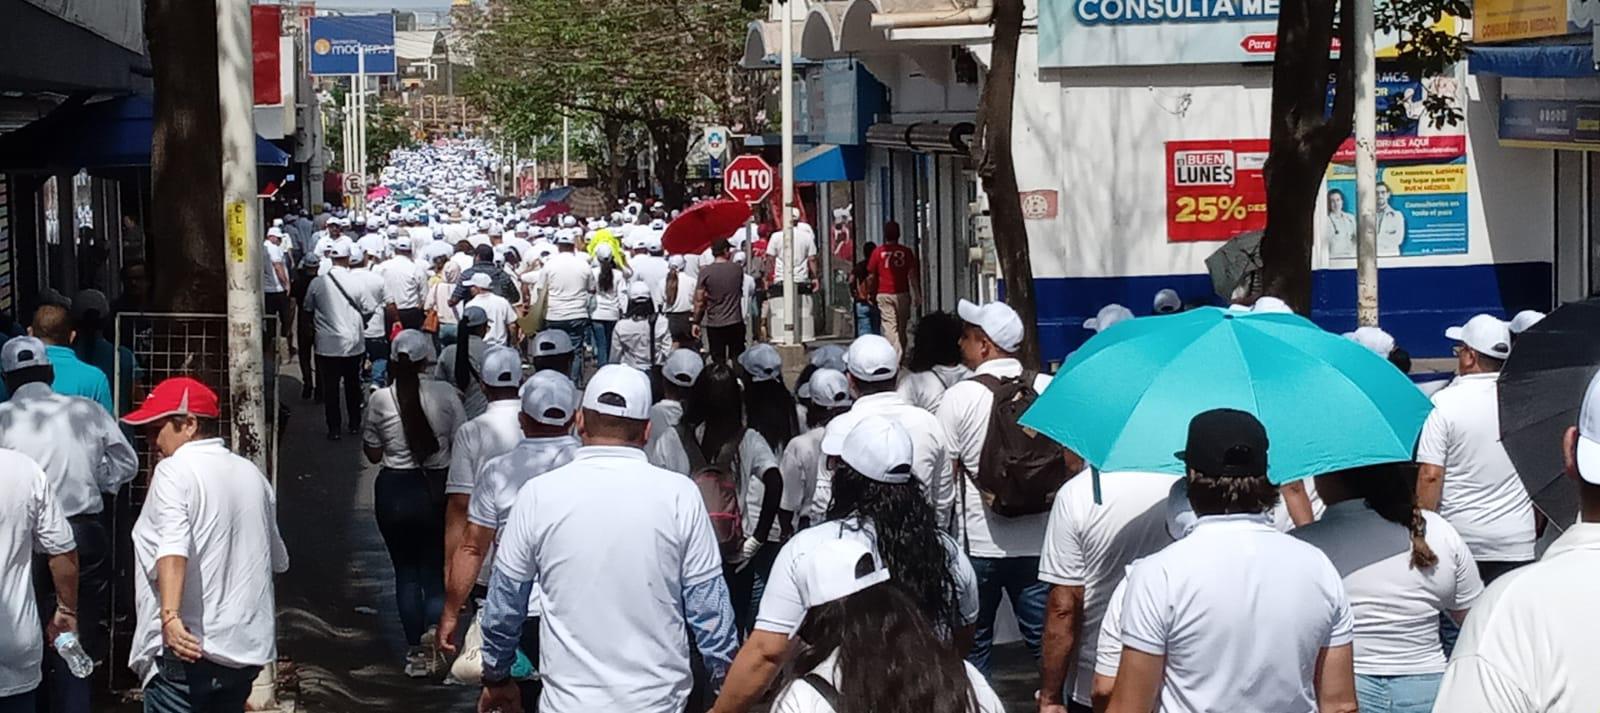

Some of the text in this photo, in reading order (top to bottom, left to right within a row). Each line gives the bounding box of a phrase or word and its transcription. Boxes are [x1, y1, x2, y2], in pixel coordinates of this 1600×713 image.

[1078, 0, 1236, 20] CONSULTA
[1247, 39, 1272, 49] Para
[1187, 154, 1224, 165] BUEN
[729, 169, 770, 190] ALTO
[1175, 196, 1247, 223] 25%
[880, 251, 906, 269] 73
